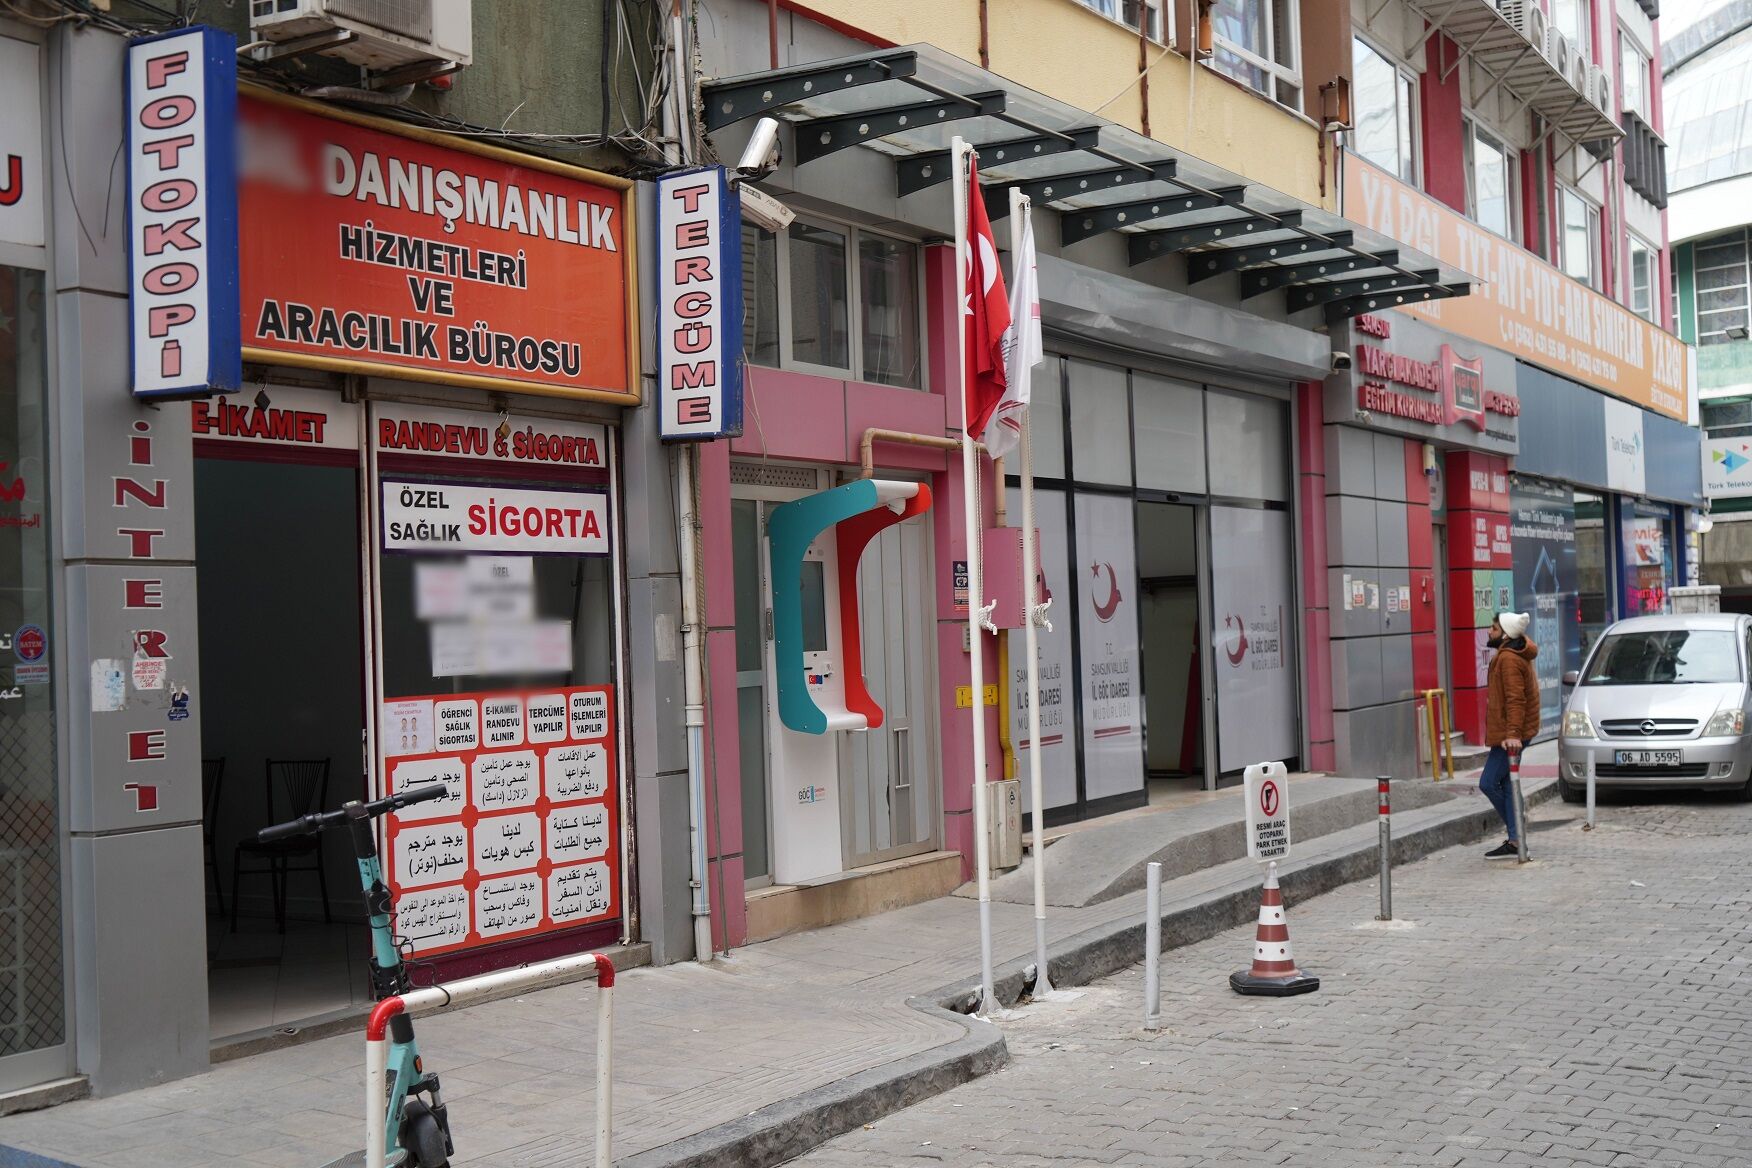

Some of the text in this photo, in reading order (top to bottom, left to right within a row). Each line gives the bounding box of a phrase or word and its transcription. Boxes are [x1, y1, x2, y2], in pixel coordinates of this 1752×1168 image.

[325, 143, 619, 254] DANIŞMANLIK
[139, 50, 202, 379] FOTOKOPİ
[338, 220, 528, 290] HİZMETLERİ
[407, 274, 455, 318] VE
[671, 182, 716, 425] TERCÜME
[1356, 313, 1392, 340] SAMSUN
[256, 299, 583, 379] ARACILIK BÜROSU
[1358, 344, 1400, 384] YARGI
[192, 396, 327, 444] E-İKAMET
[379, 418, 600, 465] RANDEVU & SİGORTA
[1707, 482, 1724, 490] Türk
[400, 486, 450, 509] ÖZEL
[468, 497, 602, 539] SİGORTA
[390, 518, 462, 542] SAĞLIK
[1091, 662, 1112, 678] SAMSUN
[1091, 678, 1130, 701] İL GÖÇ İDARESİ
[573, 696, 602, 707] OTURUM
[441, 706, 473, 719] ÖĞRENCİ
[486, 704, 518, 716] E-İKAMET
[529, 705, 565, 719] TERCÜME
[571, 708, 606, 722] İŞLEMLERİ
[445, 721, 471, 732] SAĞLIK
[486, 717, 520, 729] RANDEVU
[533, 721, 563, 734] YAPILIR
[1018, 708, 1063, 731] MÜRLÜĞÜ
[490, 731, 515, 742] ALINIR
[576, 723, 602, 734] YAPILIR
[439, 733, 476, 745] SİGORTASI
[583, 749, 597, 762] عمل
[1621, 752, 1633, 763] 06
[1655, 751, 1679, 763] 5595
[500, 759, 513, 771] عمل
[515, 760, 531, 769] يوجد
[442, 773, 461, 783] يوجد
[502, 822, 521, 840] لدينا
[1256, 820, 1286, 831] RESMİ ARAÇ
[554, 832, 602, 852] جميع الطلبات
[1259, 830, 1284, 840] OTOPARKI
[408, 834, 463, 856] يوجد مترجم
[481, 840, 535, 862] كبس هويات
[1256, 838, 1287, 849] PARK ETMEK
[1260, 847, 1285, 858] YASAKTIR
[557, 867, 597, 887] يتم تقديم
[520, 882, 535, 892] يوجد
[557, 885, 583, 902] السفر
[484, 913, 536, 929] صور من الهاتف
